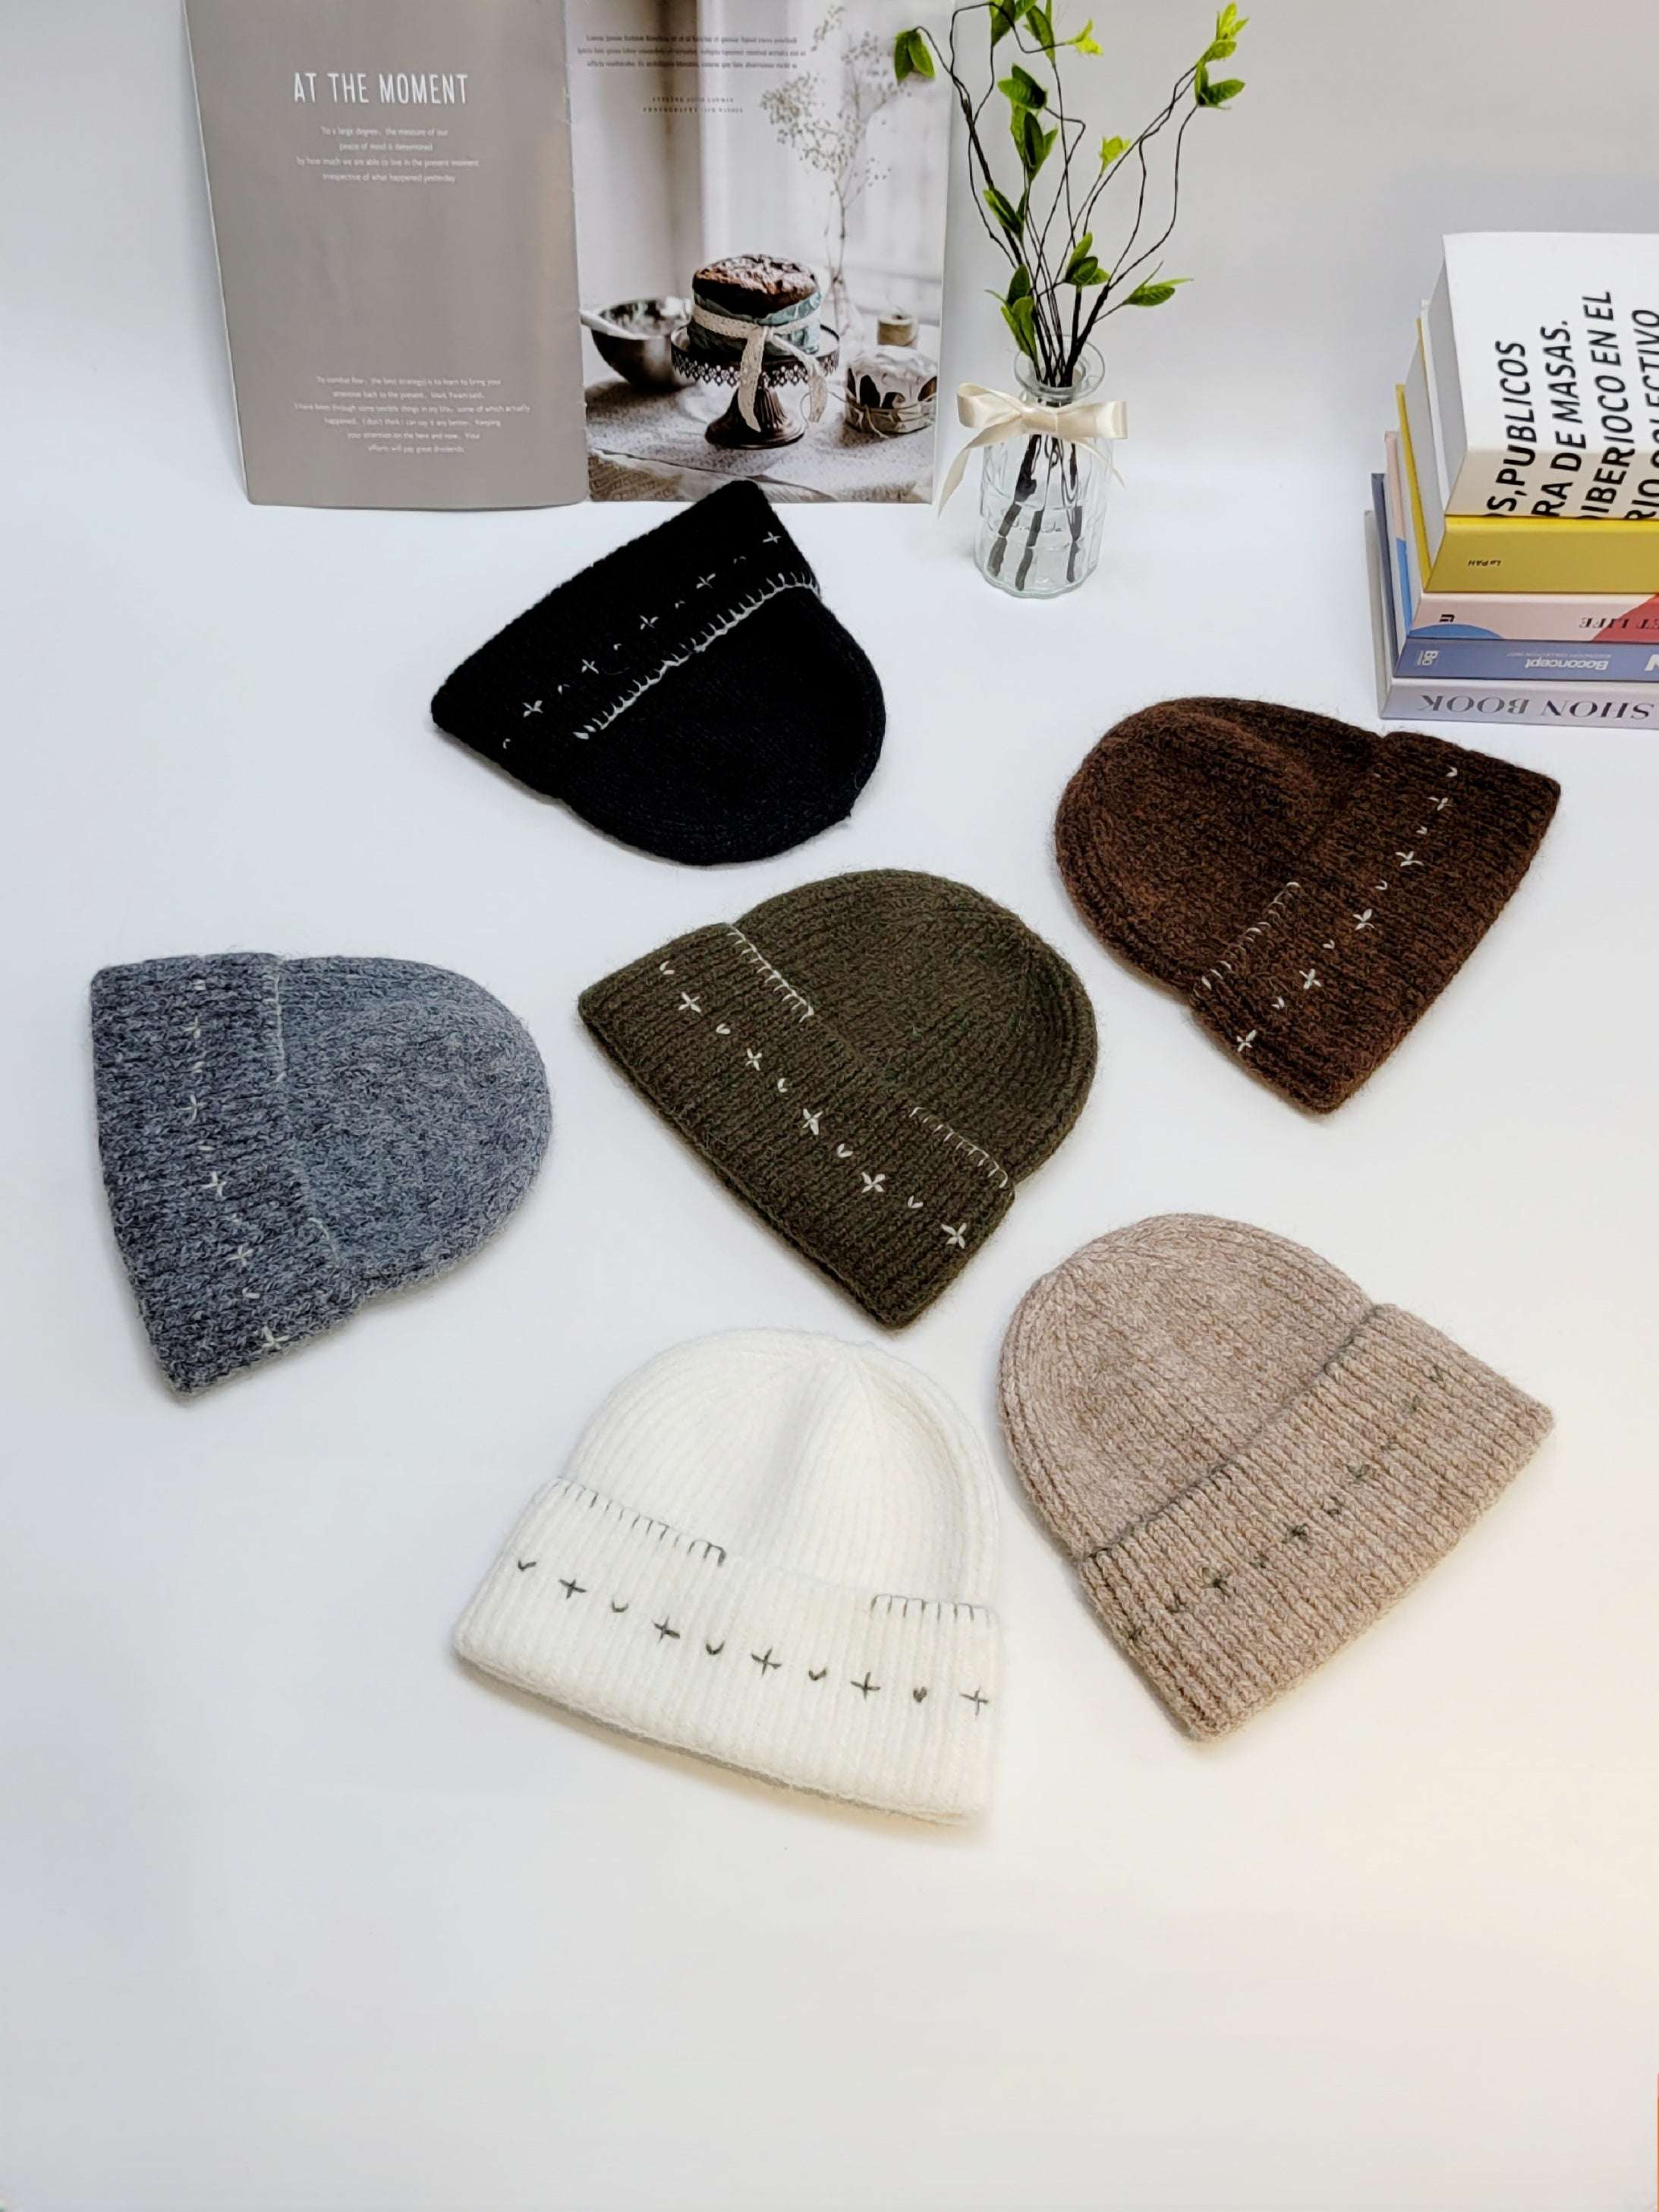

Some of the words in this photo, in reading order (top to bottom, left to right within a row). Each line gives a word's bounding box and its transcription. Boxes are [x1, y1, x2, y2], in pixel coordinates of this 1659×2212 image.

[294, 73, 316, 103] AT
[327, 73, 370, 103] THE
[379, 74, 468, 105] MOMENT
[1582, 291, 1615, 322] EL
[1586, 329, 1621, 367] EN
[1540, 320, 1583, 424] MASAS.
[1550, 430, 1586, 472] DE
[1577, 375, 1635, 519] IBERIOCO
[1579, 617, 1630, 629] LIFE
[1525, 658, 1610, 671] Boconcept
[1418, 694, 1530, 714] BOOK
